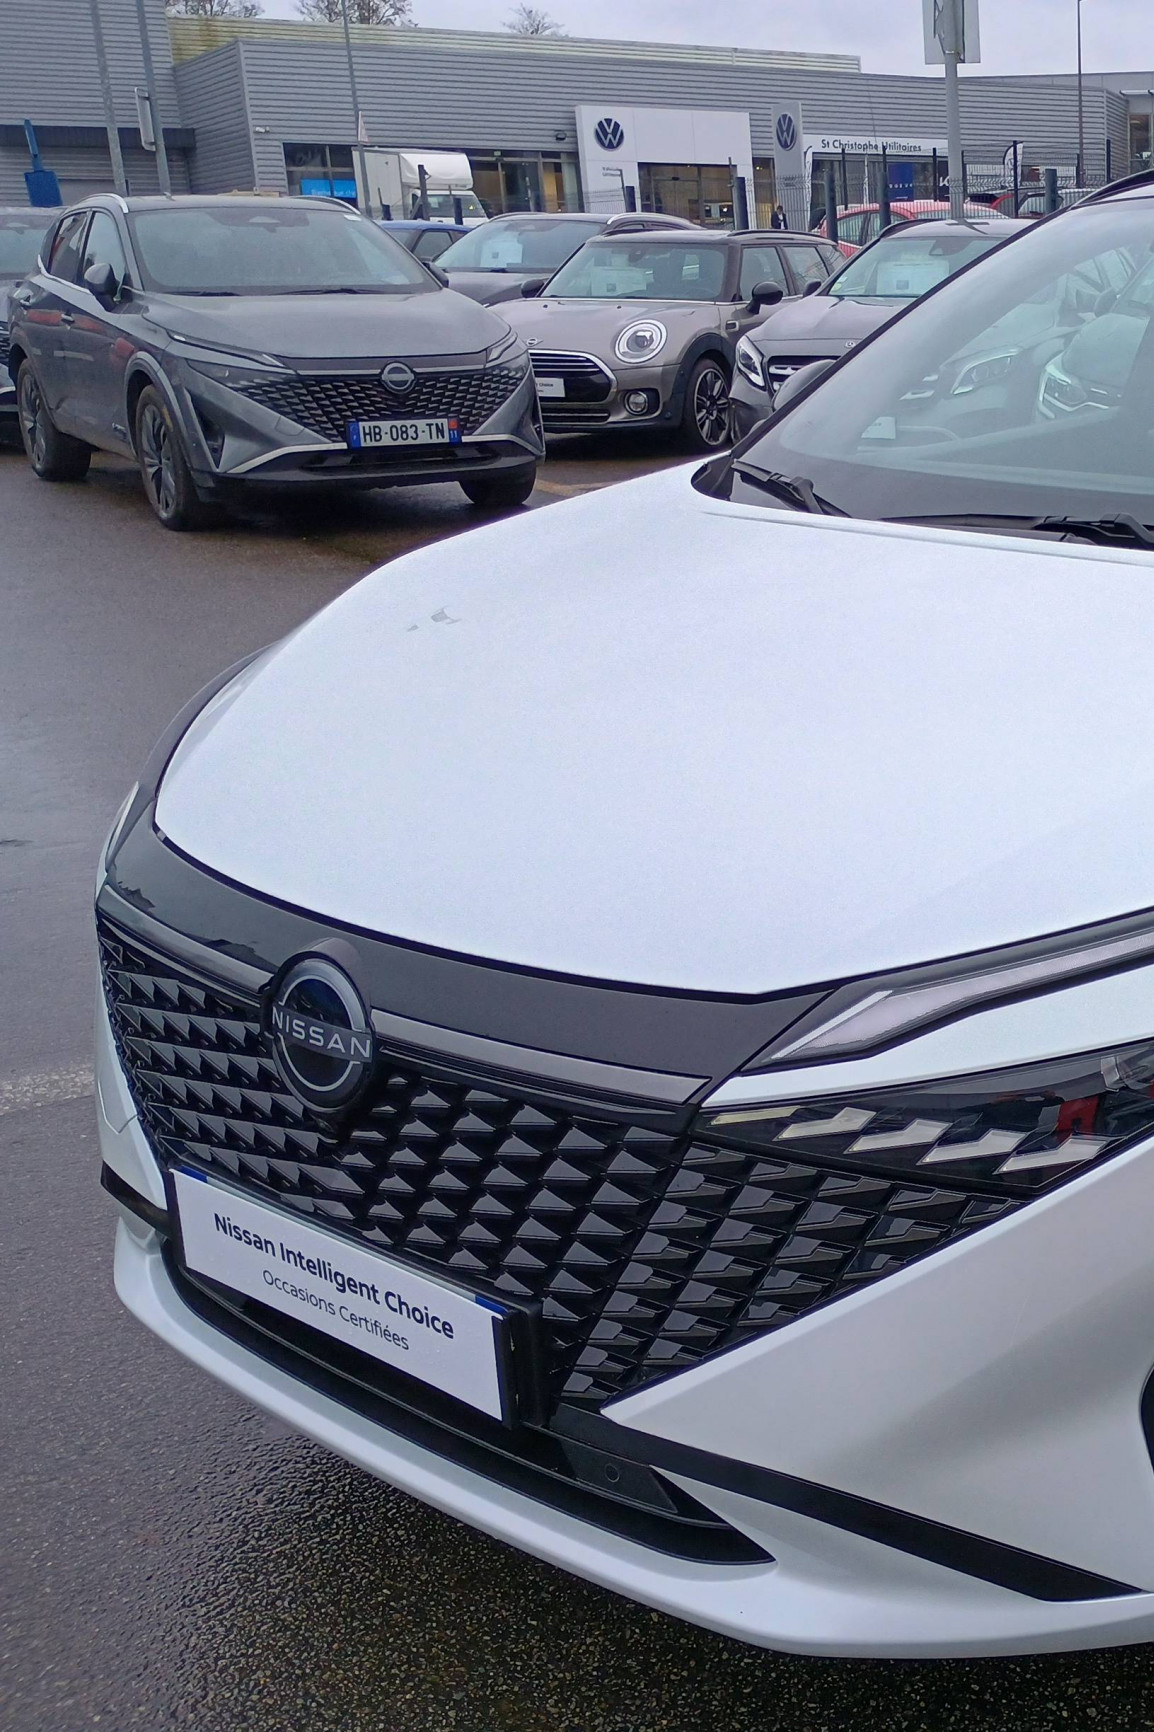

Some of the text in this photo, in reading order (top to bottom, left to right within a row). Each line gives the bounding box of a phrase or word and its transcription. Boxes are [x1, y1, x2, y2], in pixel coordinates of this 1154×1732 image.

[821, 138, 922, 152] St Christophe Utilitaires
[361, 422, 446, 443] HB-083-TN
[271, 1005, 371, 1059] NISSAN
[213, 1212, 455, 1340] Nissan Intelligent Choice
[262, 1269, 410, 1351] Occasions Certifiées
